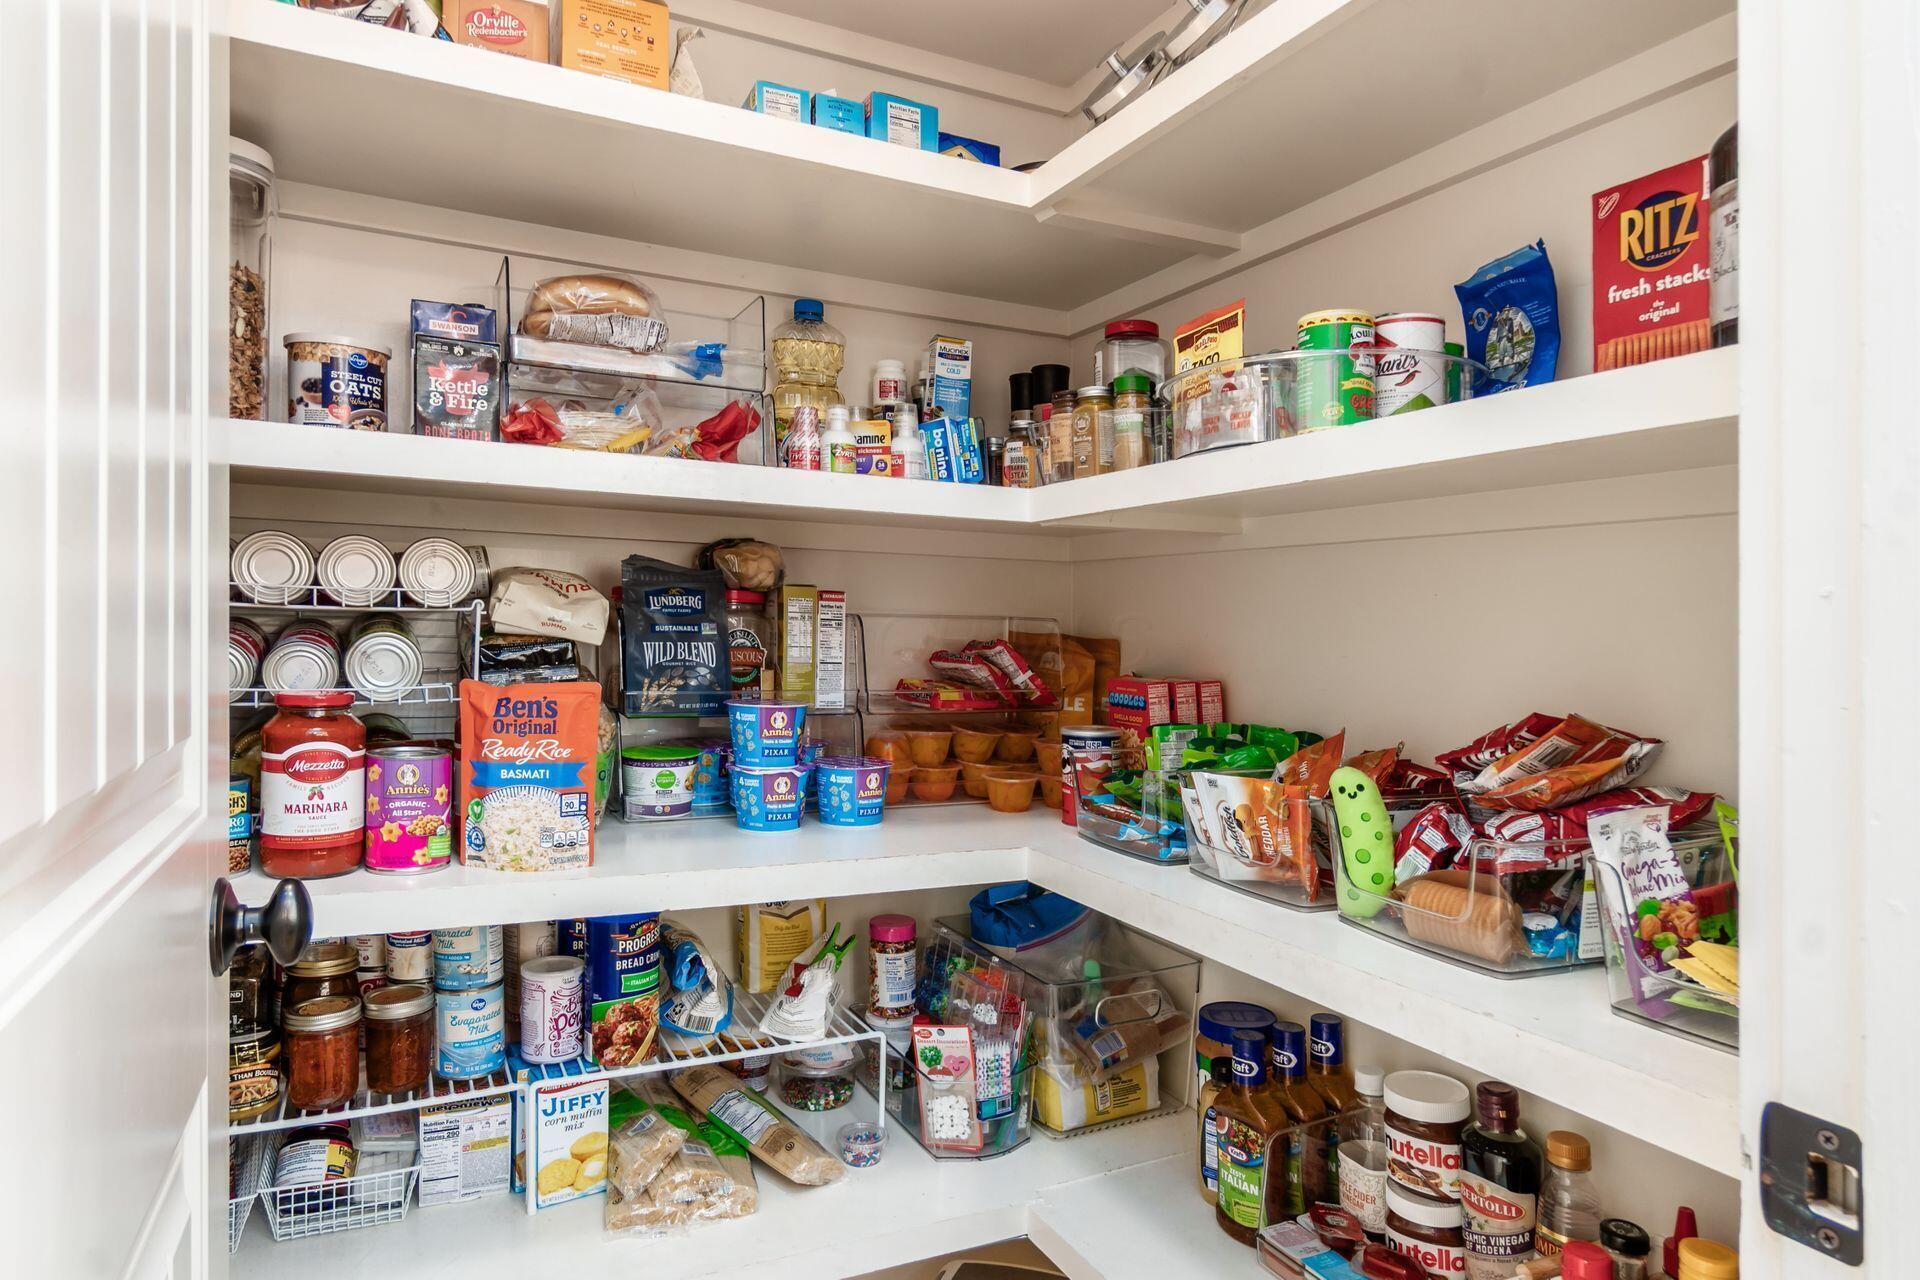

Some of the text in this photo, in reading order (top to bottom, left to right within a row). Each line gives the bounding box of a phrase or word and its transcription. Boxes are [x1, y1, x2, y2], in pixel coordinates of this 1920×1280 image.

[473, 12, 519, 28] Orville
[466, 22, 528, 38] Redenbacher's
[1620, 192, 1699, 262] RITZ
[1646, 247, 1681, 261] CRACKERS
[1608, 263, 1710, 303] fresh stacks
[1652, 299, 1665, 308] the
[1639, 301, 1680, 322] original
[431, 321, 477, 334] SWANSON
[939, 345, 969, 355] Mucinex
[1192, 352, 1220, 368] TACO
[330, 370, 383, 386] STEEL CUT
[329, 379, 382, 400] OATS
[429, 376, 488, 396] Kettle
[1187, 382, 1210, 399] ORIGIN
[429, 392, 488, 411] & Fire
[854, 434, 886, 444] amine
[932, 428, 949, 479] bonine
[649, 595, 702, 610] LUNDBERG
[541, 621, 567, 632] RUMMO
[643, 641, 717, 670] WILD BLEND
[730, 650, 764, 664] USCOUS
[493, 696, 558, 719] Ben's
[1109, 692, 1145, 708] GOODLES
[1129, 713, 1143, 723] GOOD
[493, 719, 558, 738] Original
[762, 727, 793, 738] Annie's
[482, 738, 572, 765] Ready Rice
[764, 748, 789, 756] PIXAR
[288, 757, 346, 773] Mezzetta
[500, 768, 550, 780] BASMATI
[739, 776, 745, 785] 4
[829, 774, 836, 782] 4
[386, 784, 431, 795] Annie's
[765, 792, 797, 802] Annie's
[858, 789, 883, 798] Annie's
[284, 801, 348, 814] MARINARA
[389, 800, 427, 808] ORGANIC
[564, 801, 575, 810] 90
[768, 812, 792, 820] PIXAR
[1222, 805, 1250, 860] Goldfish
[1258, 815, 1277, 858] HEDDAR
[437, 939, 455, 950] Milk
[619, 928, 660, 953] PROGRES
[616, 957, 644, 970] BREAD
[630, 977, 650, 986] ITALIAN
[450, 1009, 501, 1027] Evaporated
[468, 1023, 490, 1036] Milk
[1232, 1059, 1251, 1074] Kraft
[233, 1072, 253, 1081] THAN
[542, 1090, 606, 1117] JIFFY
[446, 1118, 460, 1126] Facts
[544, 1107, 602, 1128] corn muffin
[565, 1121, 585, 1132] mix
[1229, 1147, 1247, 1160] Kraft
[1385, 1131, 1461, 1170] nutella
[1229, 1167, 1246, 1180] ZESTY
[1221, 1168, 1260, 1196] ITALIAN
[1342, 1193, 1365, 1211] VINEGAR
[1353, 1187, 1377, 1205] CIDER
[1461, 1185, 1518, 1218] BERTOLLI
[1463, 1230, 1530, 1246] LSAMIC VINEGAR
[1465, 1240, 1512, 1256] OF MODENA
